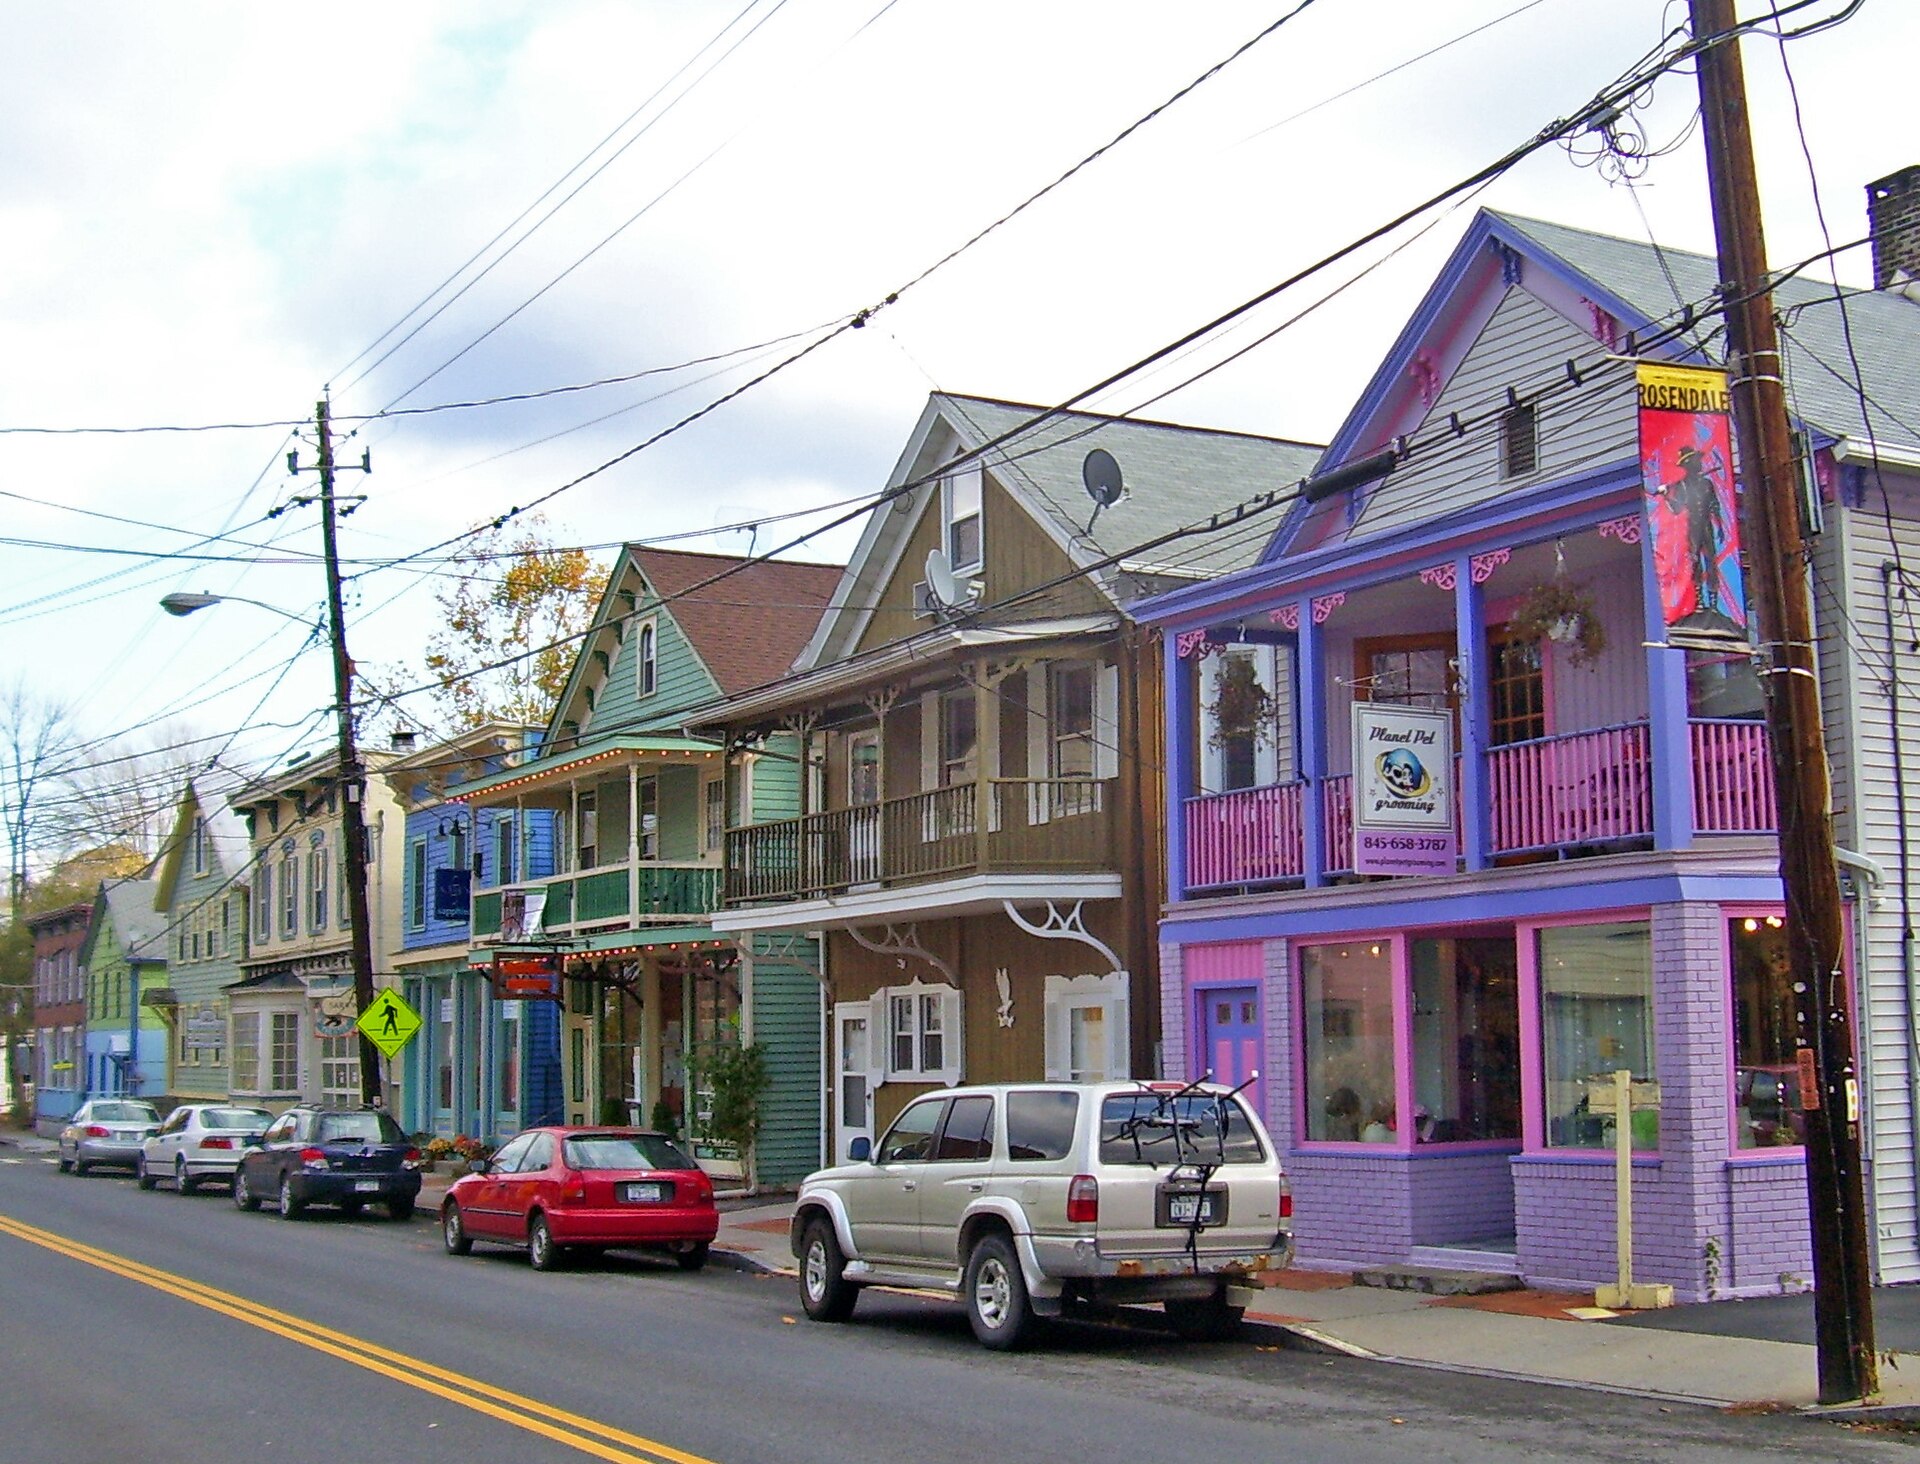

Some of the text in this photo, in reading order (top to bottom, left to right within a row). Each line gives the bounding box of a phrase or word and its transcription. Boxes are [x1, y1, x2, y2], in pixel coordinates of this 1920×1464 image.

[1637, 383, 1730, 412] ROSENDALE
[1369, 726, 1435, 745] Planet Pet
[1374, 797, 1435, 815] grooming
[1364, 836, 1447, 852] 845-658-3787
